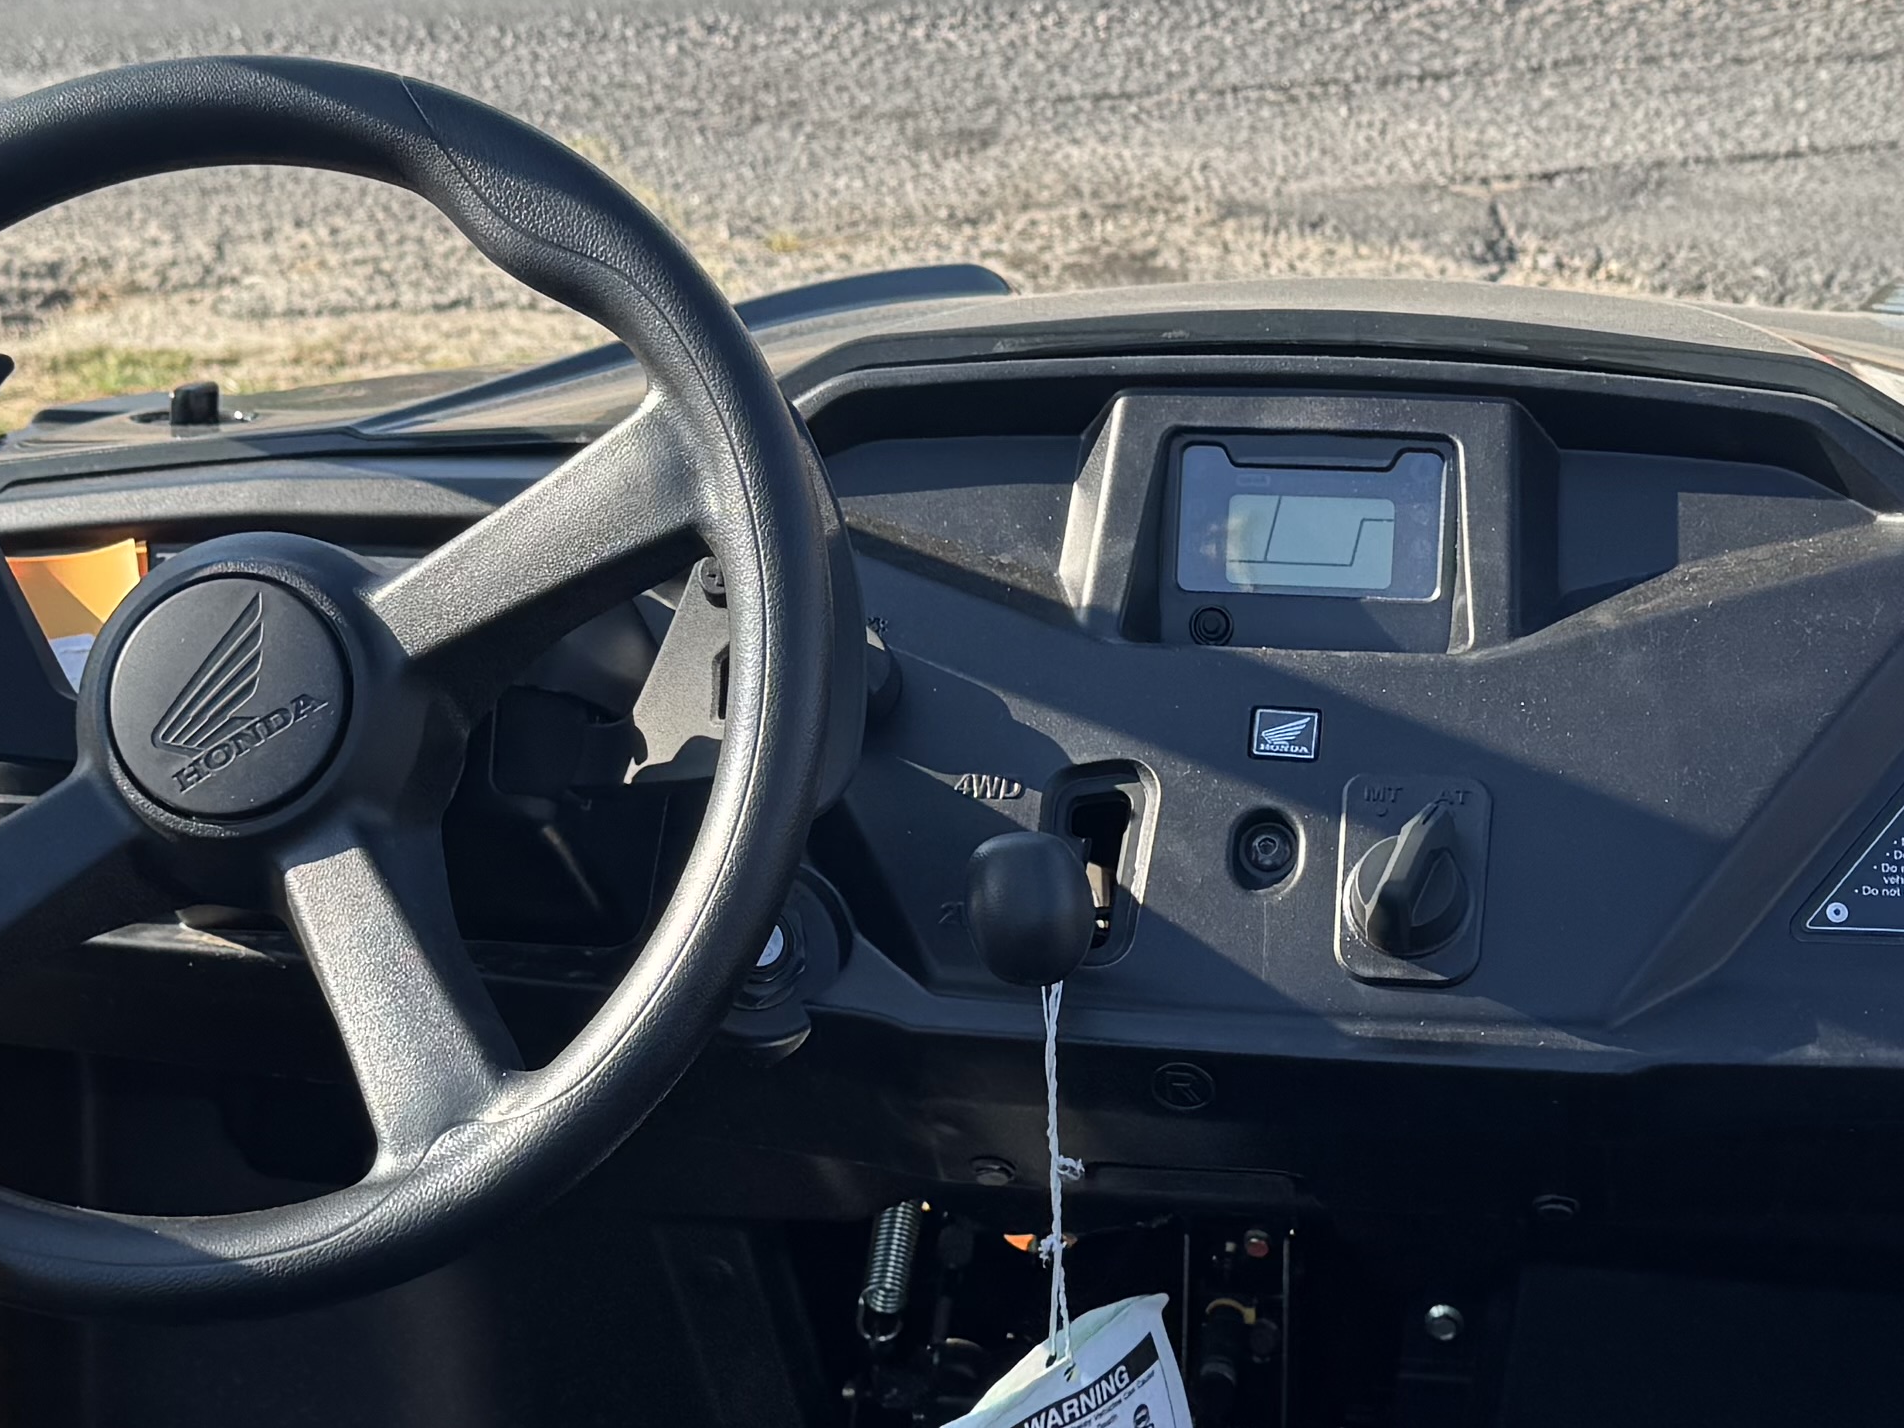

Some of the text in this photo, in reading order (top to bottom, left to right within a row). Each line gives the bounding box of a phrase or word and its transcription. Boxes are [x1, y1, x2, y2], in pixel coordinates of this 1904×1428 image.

[171, 692, 329, 794] HONDA
[1259, 743, 1310, 754] HONDA
[954, 773, 1022, 800] 4WD
[1881, 863, 1897, 873] Do
